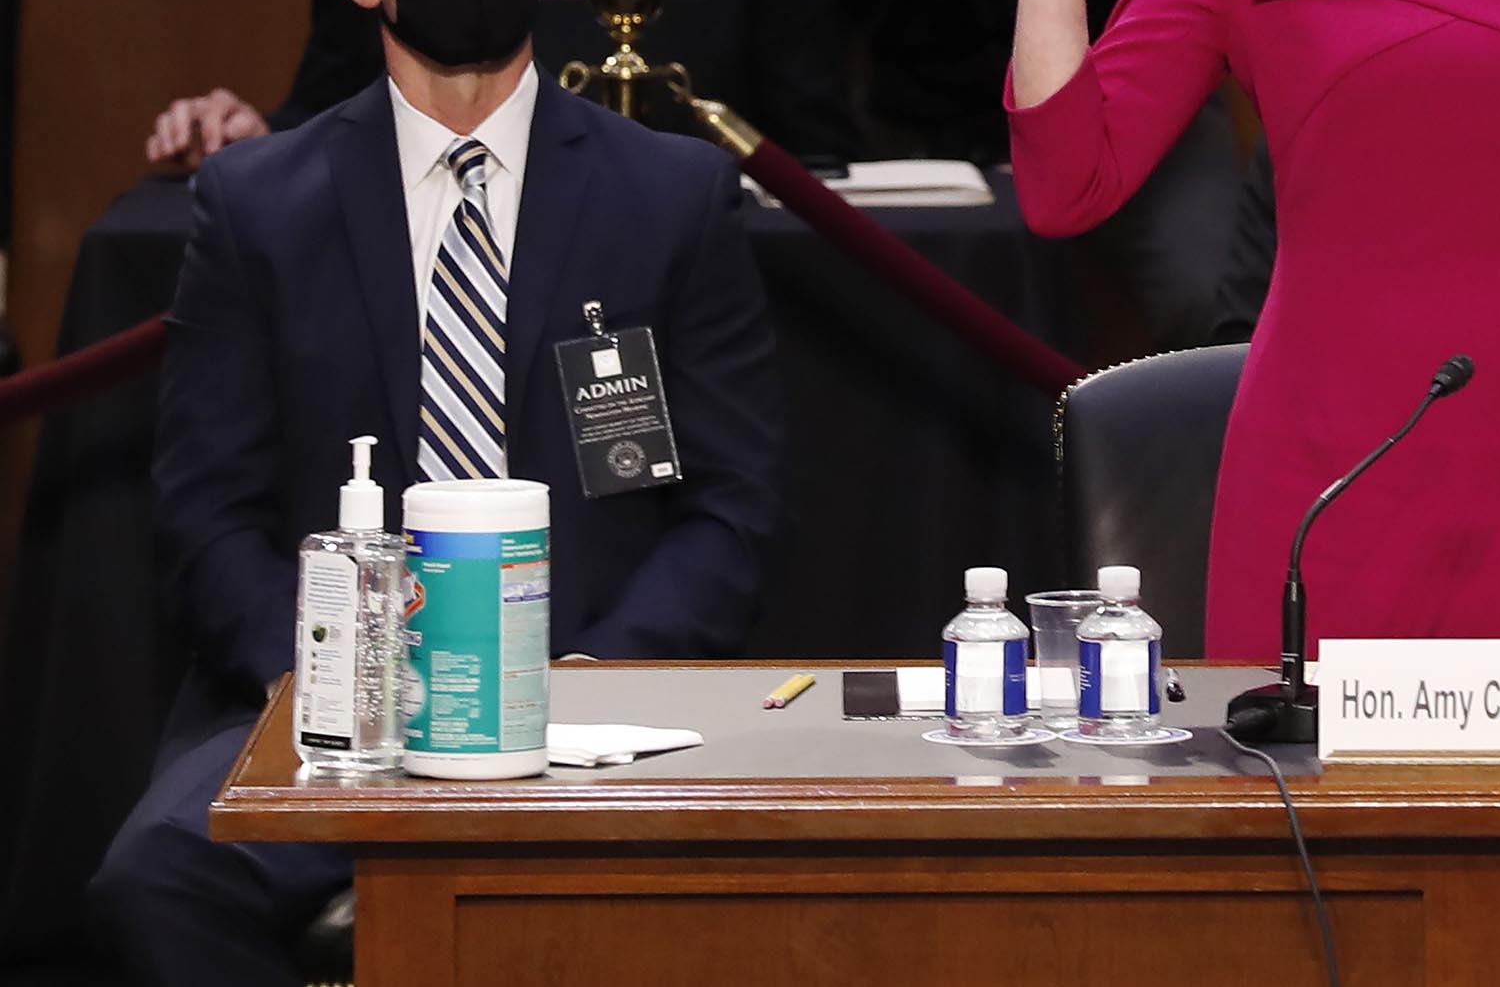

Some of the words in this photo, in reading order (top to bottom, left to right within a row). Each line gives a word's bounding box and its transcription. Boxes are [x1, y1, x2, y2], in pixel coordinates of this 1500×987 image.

[576, 375, 648, 401] ADMIN
[1342, 679, 1402, 720] Hon.
[1413, 679, 1474, 731] Amy
